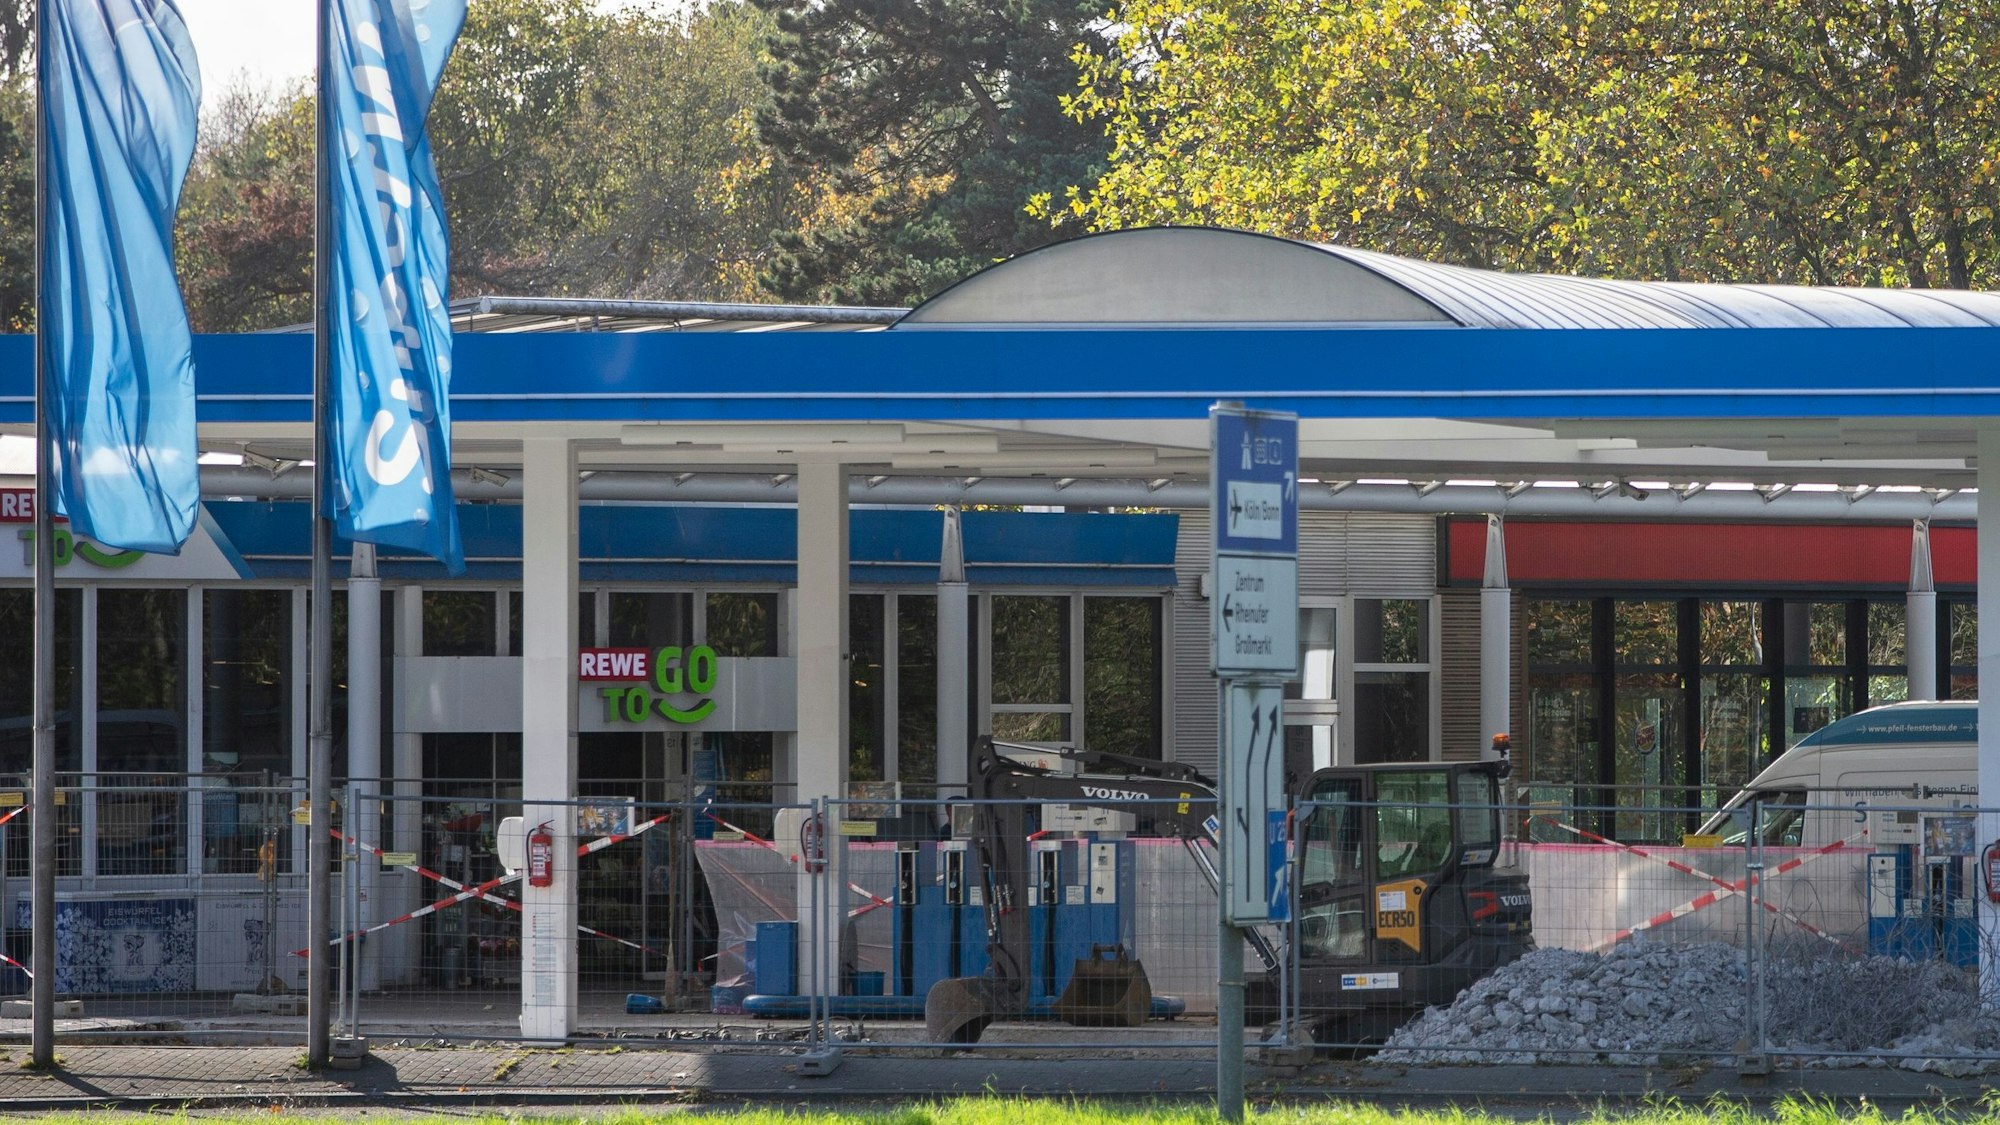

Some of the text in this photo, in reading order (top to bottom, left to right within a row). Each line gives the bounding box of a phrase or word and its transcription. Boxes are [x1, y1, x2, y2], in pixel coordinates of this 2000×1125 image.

[1235, 570, 1264, 592] Zentrum
[1235, 602, 1269, 624] Rheinufer
[1235, 634, 1272, 655] Großmarkt
[580, 645, 718, 694] REWE GO
[602, 686, 651, 723] TO
[1868, 724, 1958, 734] www.pfeil-fensterbau.de
[1080, 785, 1150, 801] VOLVO
[107, 906, 162, 916] EISWÜRFEL
[1378, 911, 1415, 928] ECR50
[103, 917, 149, 926] COCKTAIL
